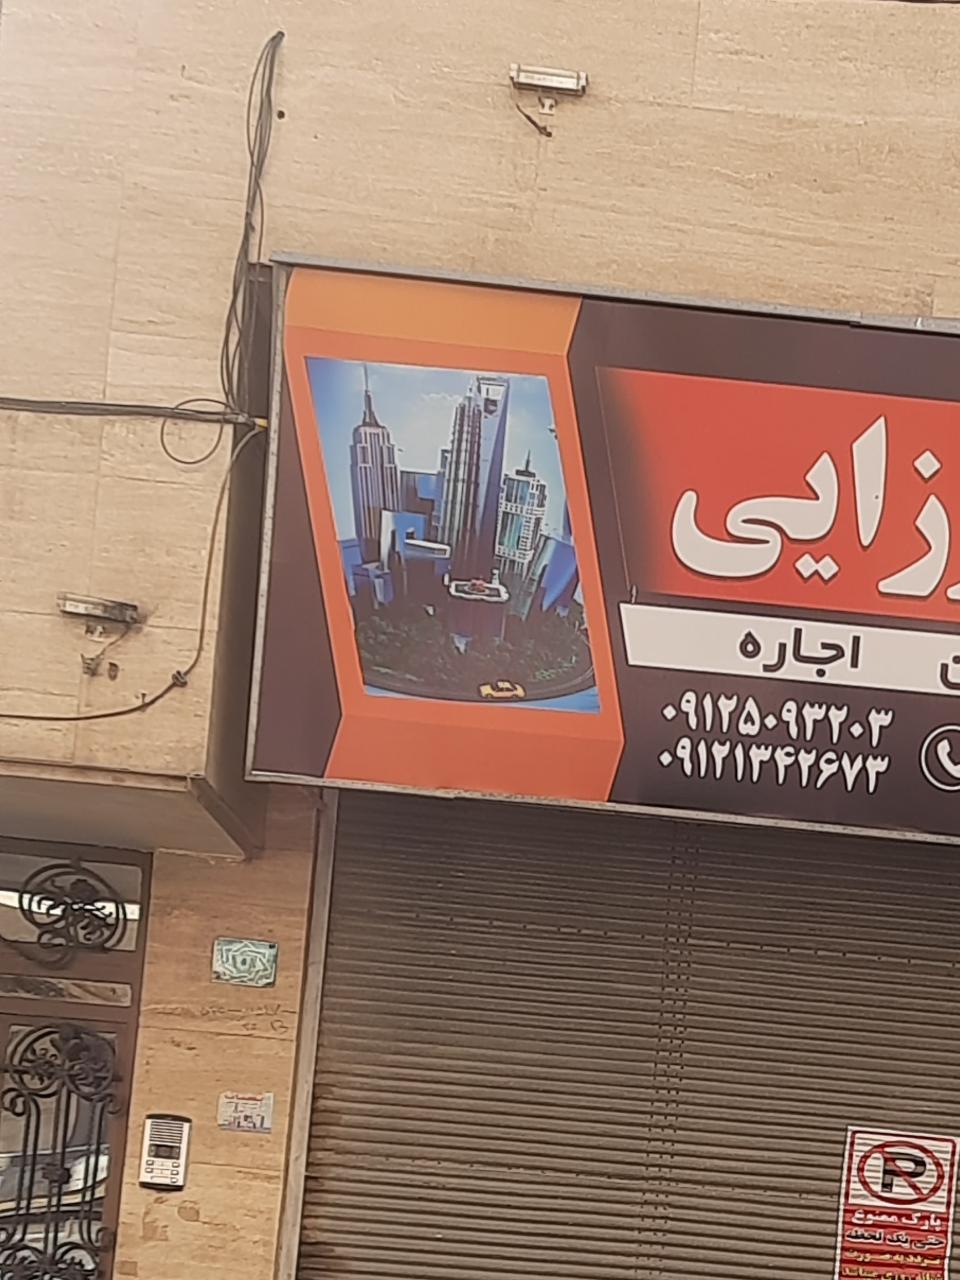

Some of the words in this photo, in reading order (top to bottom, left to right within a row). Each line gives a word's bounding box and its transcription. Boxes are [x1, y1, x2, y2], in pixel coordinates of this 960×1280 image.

[739, 627, 861, 678] اجاره
[662, 690, 893, 748] ۰۹۱۲۵۰۹۳۲۰۳
[658, 737, 889, 794] ۰۹۱۲۱۳۴۲۶۷۳
[851, 1209, 898, 1225] ممنوع
[901, 1212, 942, 1232] پارک
[886, 1231, 910, 1247] یک
[912, 1235, 946, 1250] حتی
